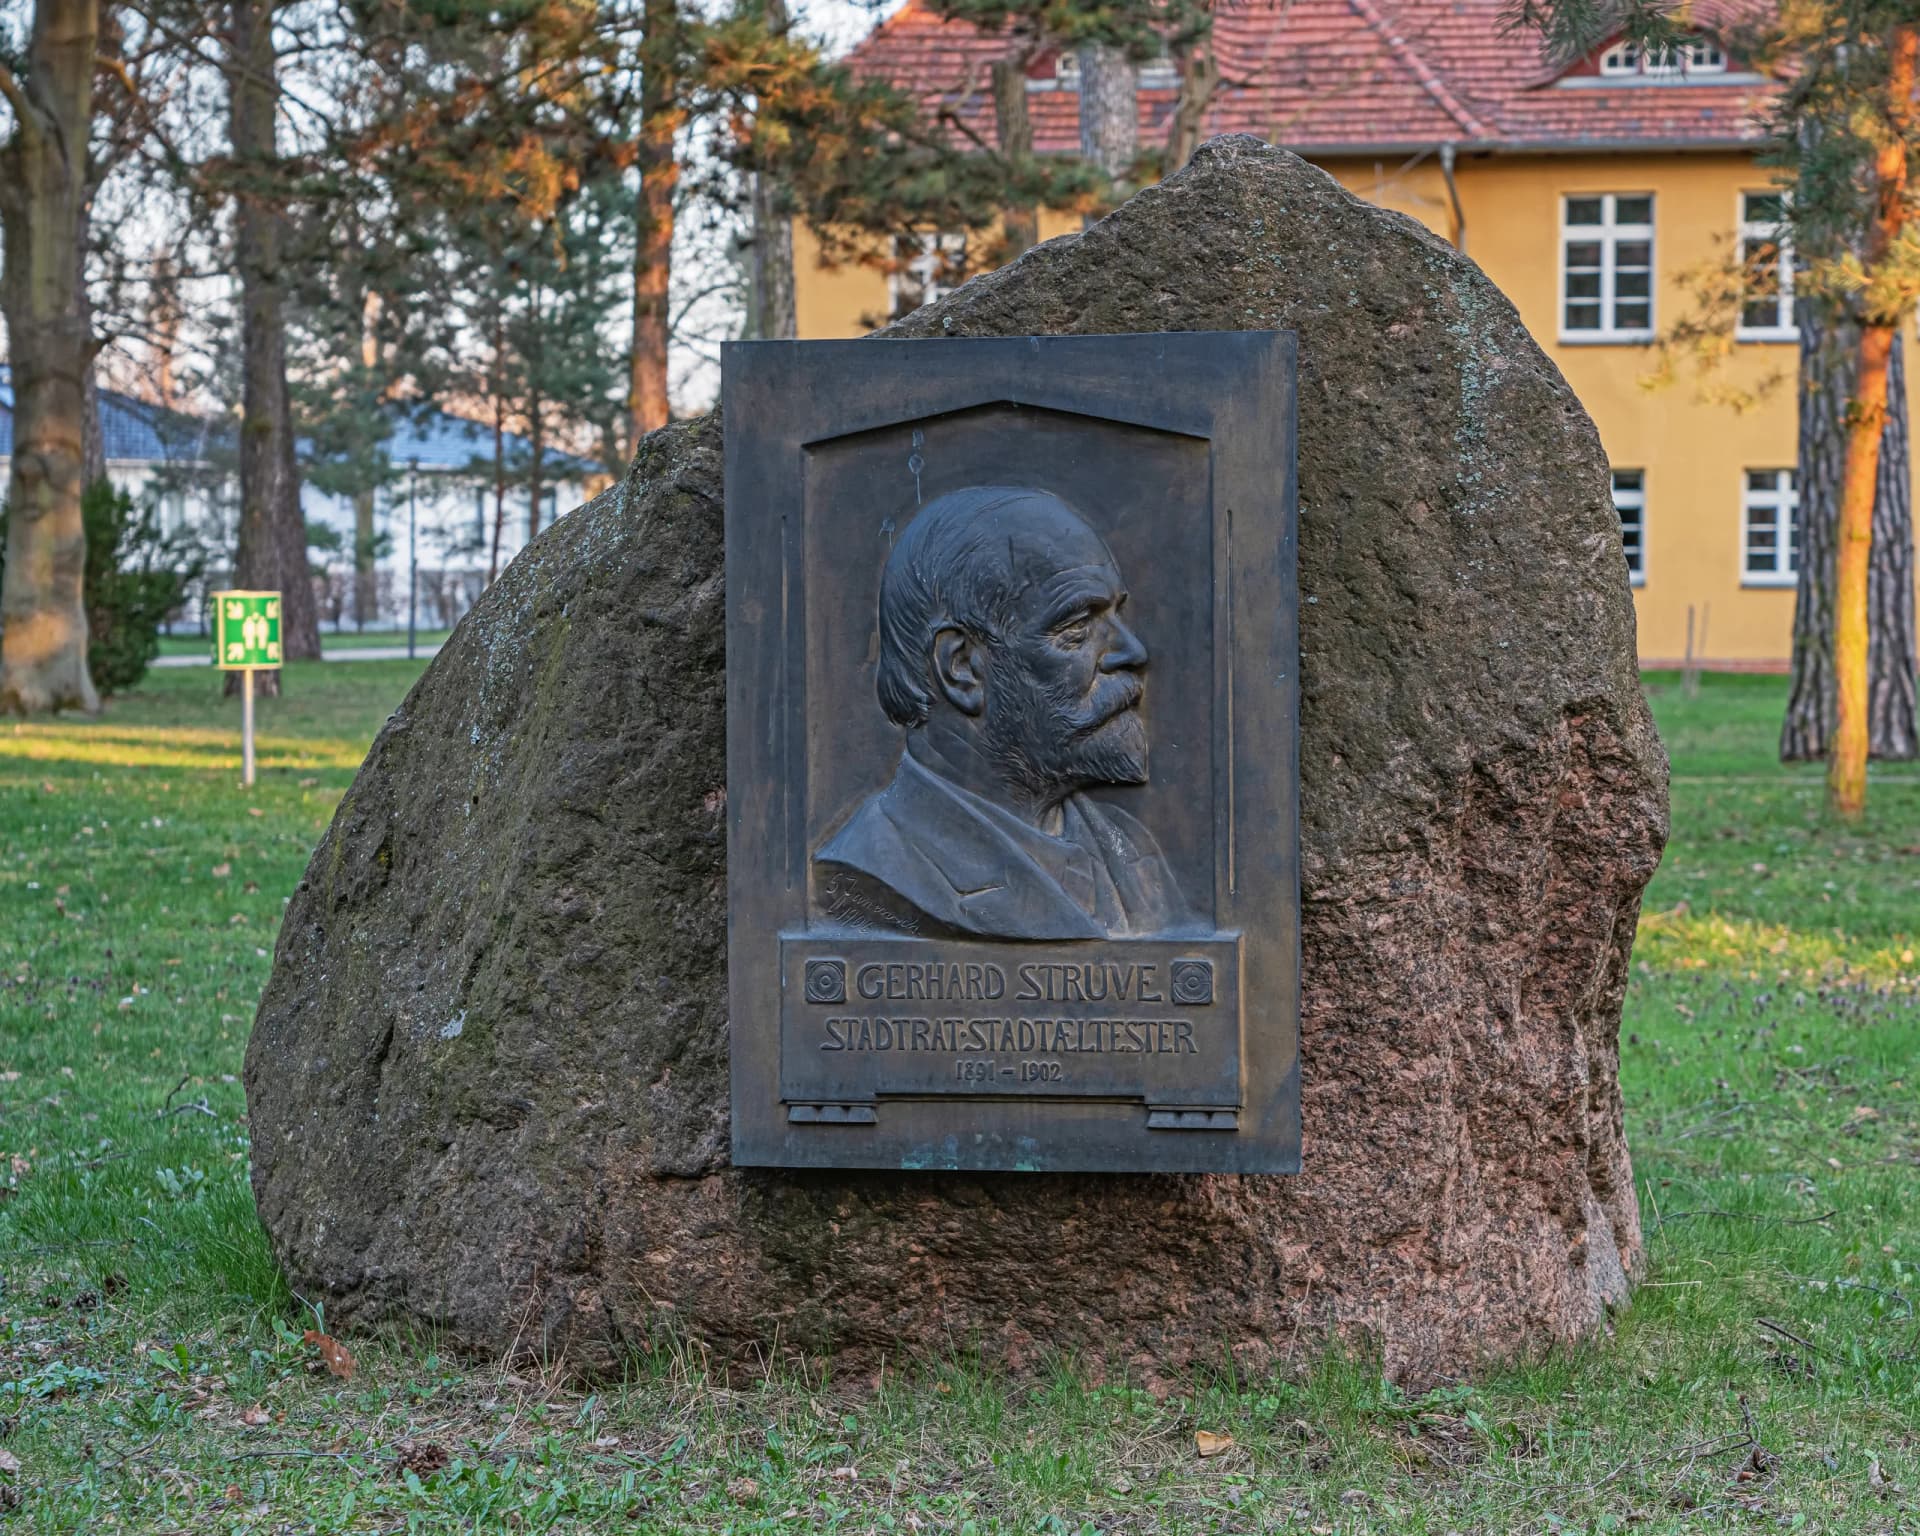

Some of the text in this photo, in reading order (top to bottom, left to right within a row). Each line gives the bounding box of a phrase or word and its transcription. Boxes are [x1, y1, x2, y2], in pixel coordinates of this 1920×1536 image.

[856, 963, 1162, 1001] GERHARD STRUVE
[956, 1060, 995, 1081] 1891
[1021, 1060, 1063, 1082] 1902
